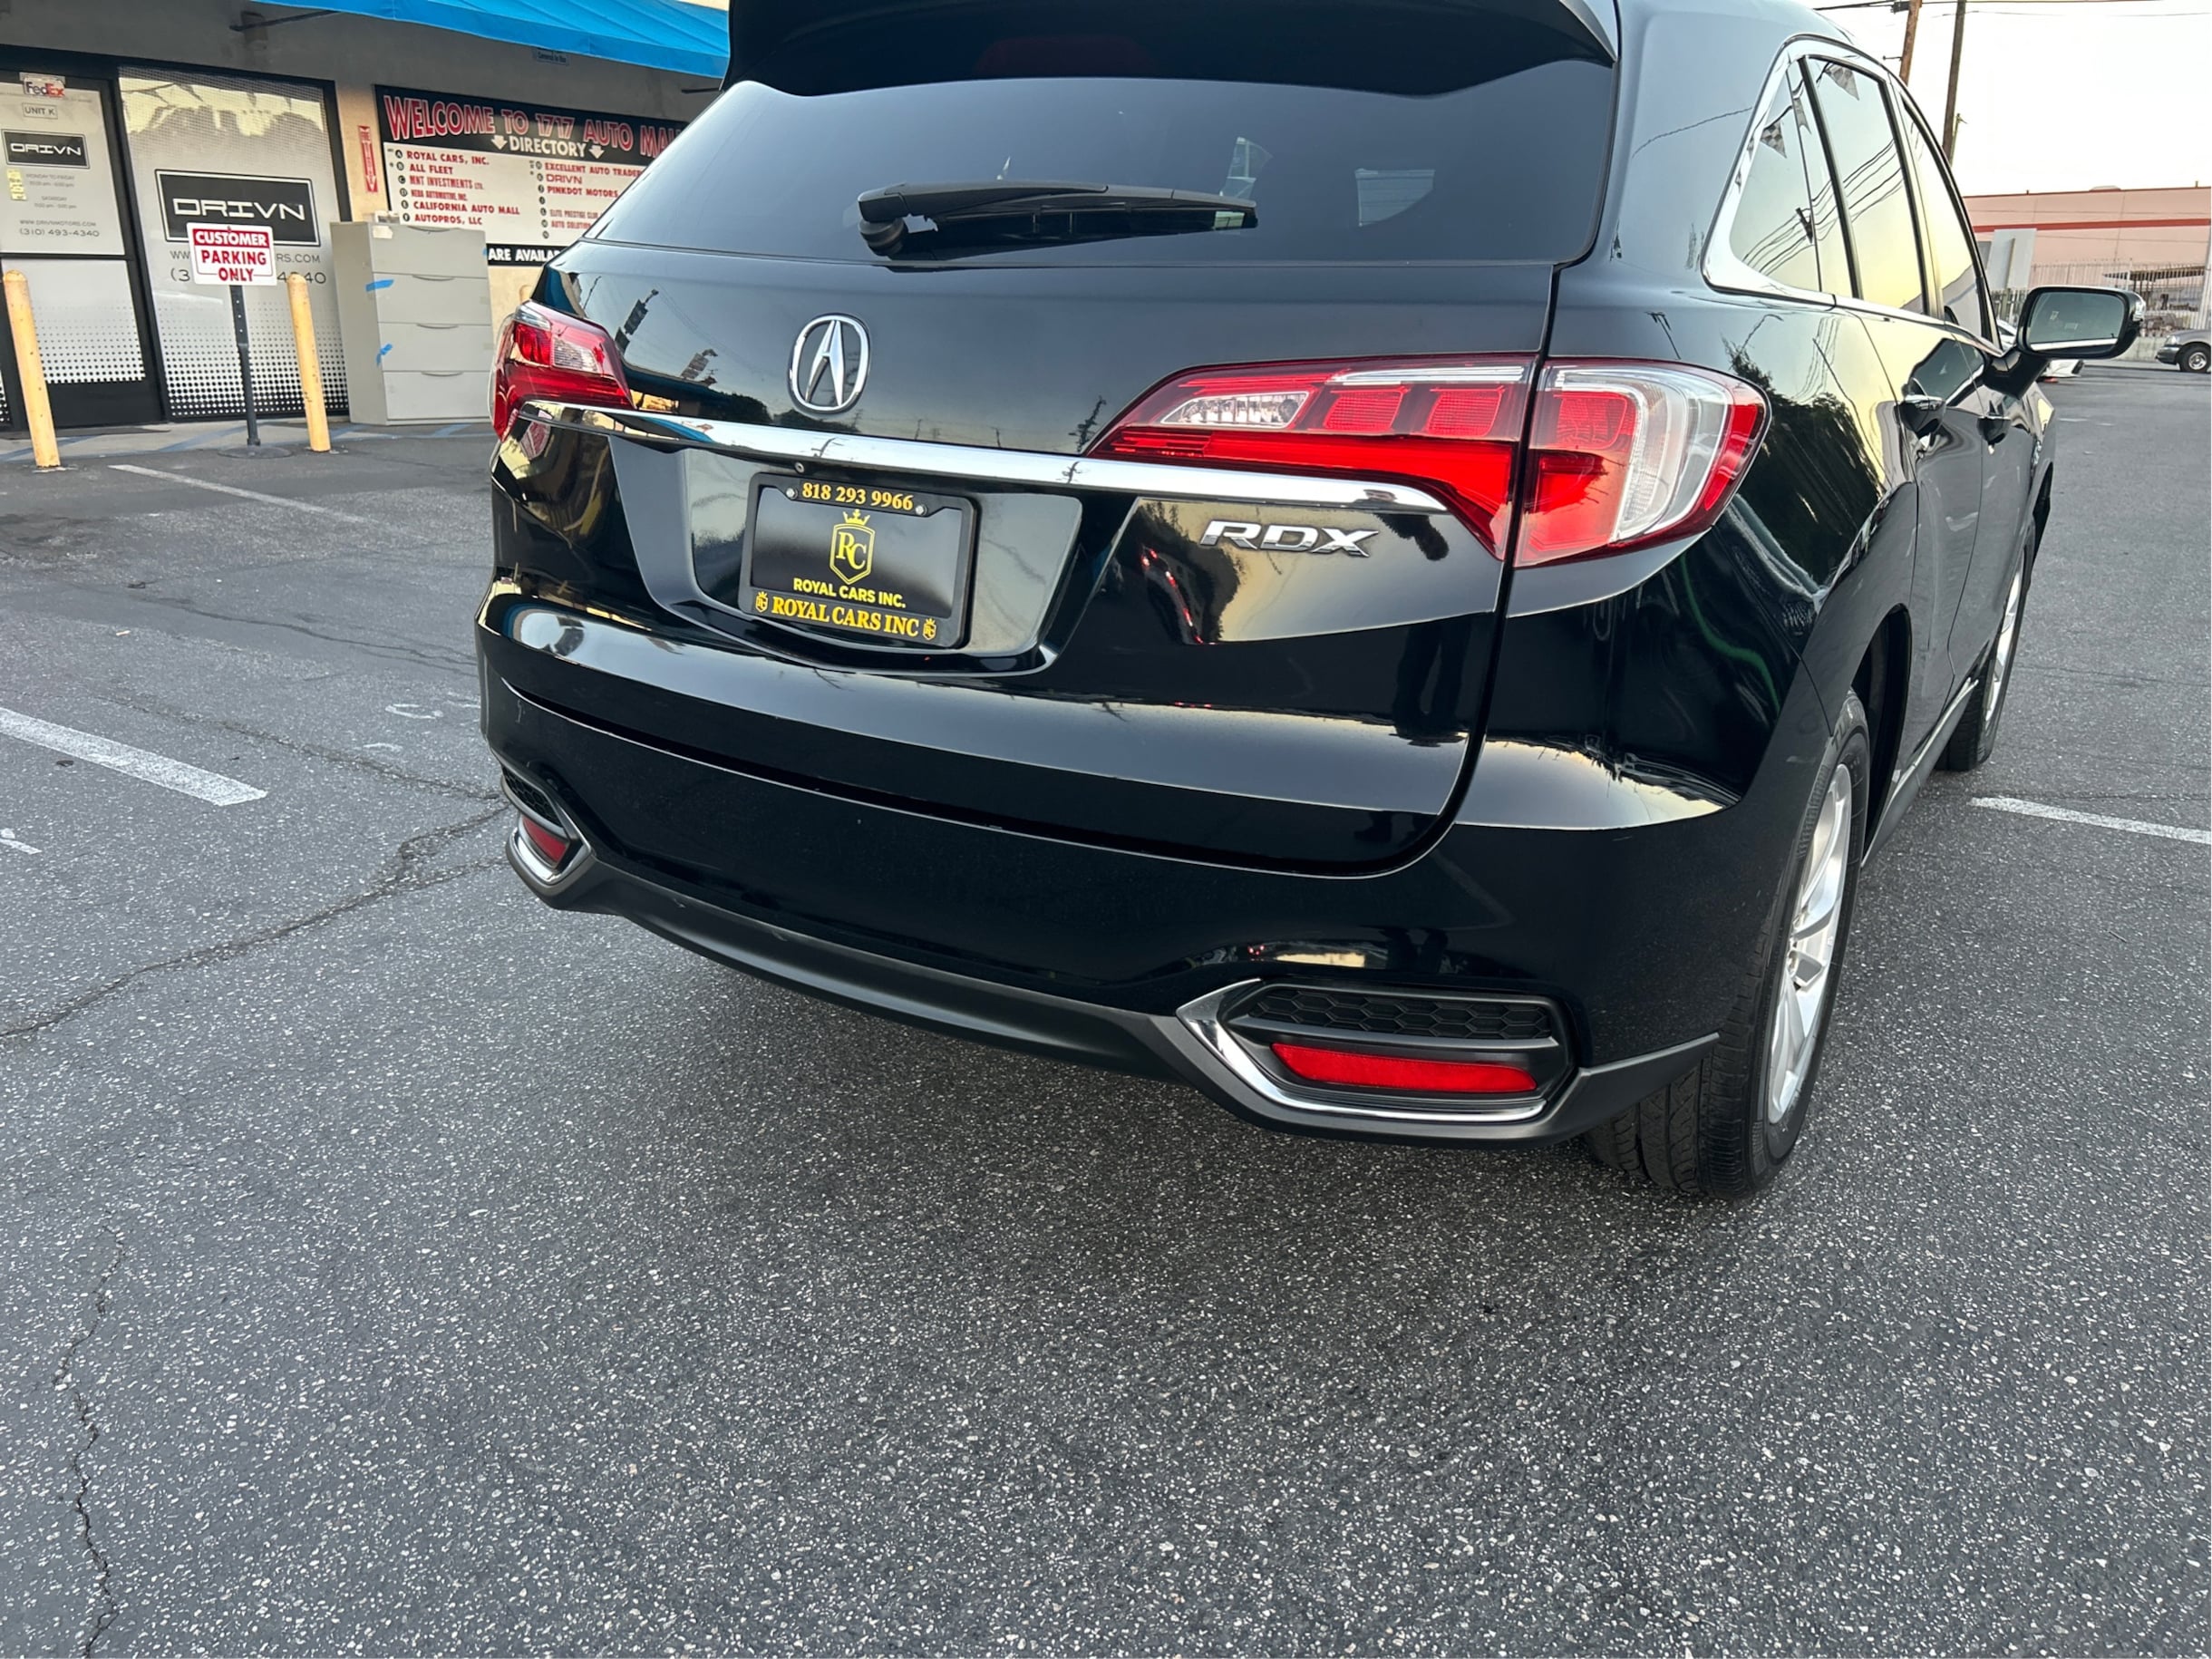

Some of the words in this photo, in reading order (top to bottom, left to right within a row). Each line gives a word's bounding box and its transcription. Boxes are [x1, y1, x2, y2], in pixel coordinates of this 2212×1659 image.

[24, 81, 65, 98] FedEx
[24, 106, 45, 114] UNIT
[383, 94, 495, 141] WELCOME
[501, 109, 529, 135] TO
[536, 113, 575, 140] 1717
[583, 119, 634, 151] AUTO
[640, 125, 682, 159] MAL
[10, 143, 82, 157] DRIVN
[509, 136, 587, 158] DIRECTORY
[406, 150, 437, 162] ROYAL
[440, 153, 468, 165] CARS,
[471, 156, 490, 166] INC.
[410, 163, 425, 173] ALL
[429, 165, 453, 175] FLEET
[545, 162, 586, 173] EXCELLENT
[589, 165, 610, 175] AUTO
[427, 177, 473, 189] INVESTMENTS
[546, 173, 582, 184] DRIVN
[547, 186, 582, 196] PINKDOT
[586, 189, 618, 199] MOTORS
[172, 198, 306, 220] DRIVN
[413, 201, 468, 212] CALIFORNIA
[471, 204, 494, 214] AUTO
[498, 206, 520, 215] MALL
[469, 216, 482, 225] LLC
[195, 230, 268, 247] CUSTOMER
[201, 249, 267, 266] PARKING
[489, 247, 511, 261] ARE
[218, 267, 254, 282] ONLY
[802, 482, 831, 500] 818
[835, 487, 866, 504] 293
[871, 490, 914, 510] 9966
[1200, 520, 1379, 557] RDX
[836, 531, 867, 570] RC
[793, 577, 836, 597] ROYAL
[839, 585, 876, 603] CARS
[878, 591, 906, 608] INC.
[771, 596, 830, 623] ROYAL
[831, 606, 881, 632] CARS
[884, 616, 919, 636] INC
